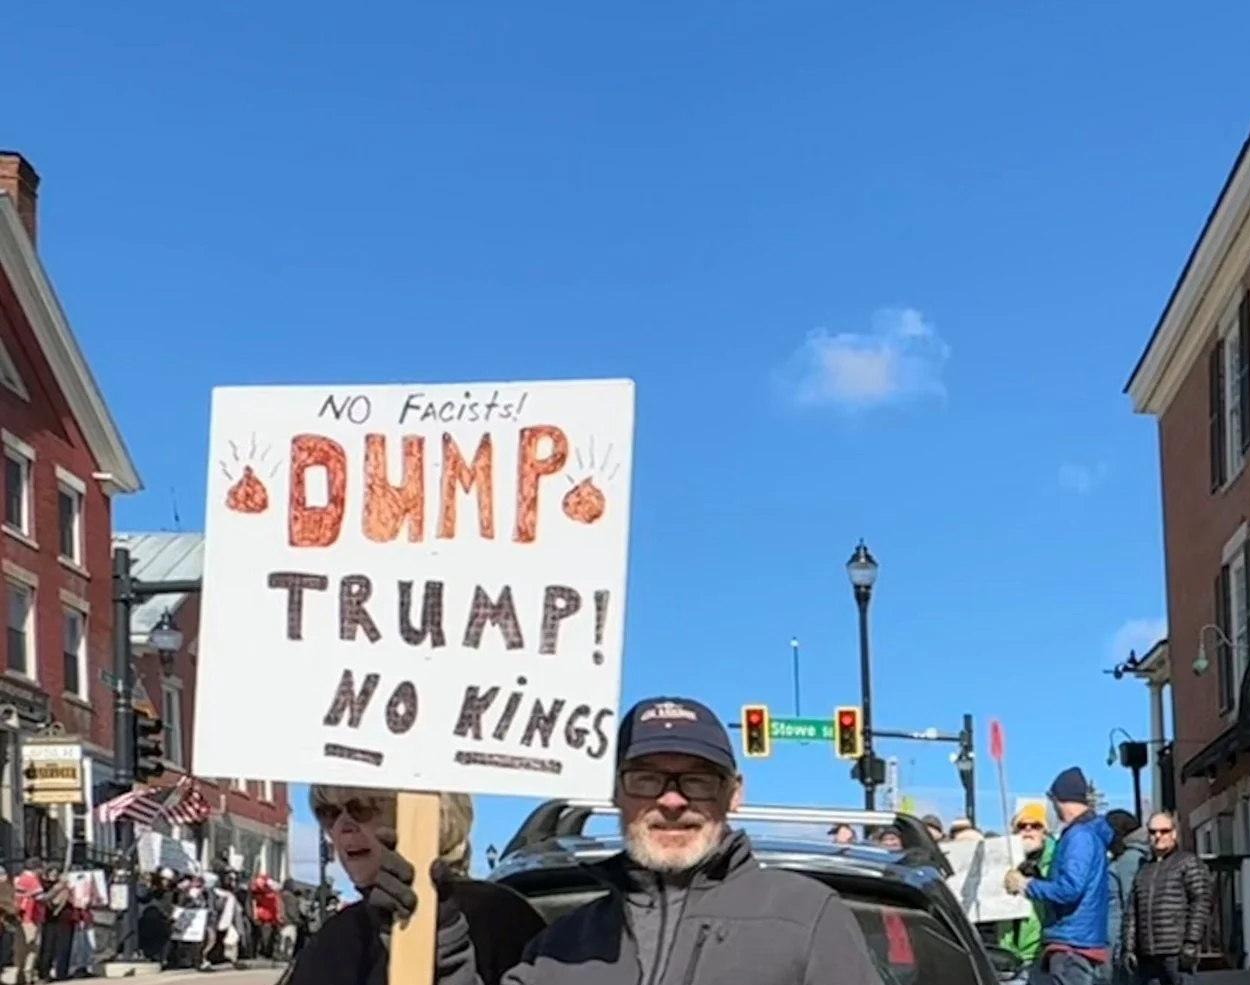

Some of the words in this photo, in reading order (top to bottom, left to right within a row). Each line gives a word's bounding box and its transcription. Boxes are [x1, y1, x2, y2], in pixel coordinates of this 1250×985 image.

[318, 394, 370, 425] NO
[287, 424, 569, 548] DUMP
[267, 571, 611, 666] TRUMP!
[322, 669, 420, 735] NO
[771, 721, 817, 738] Stowe
